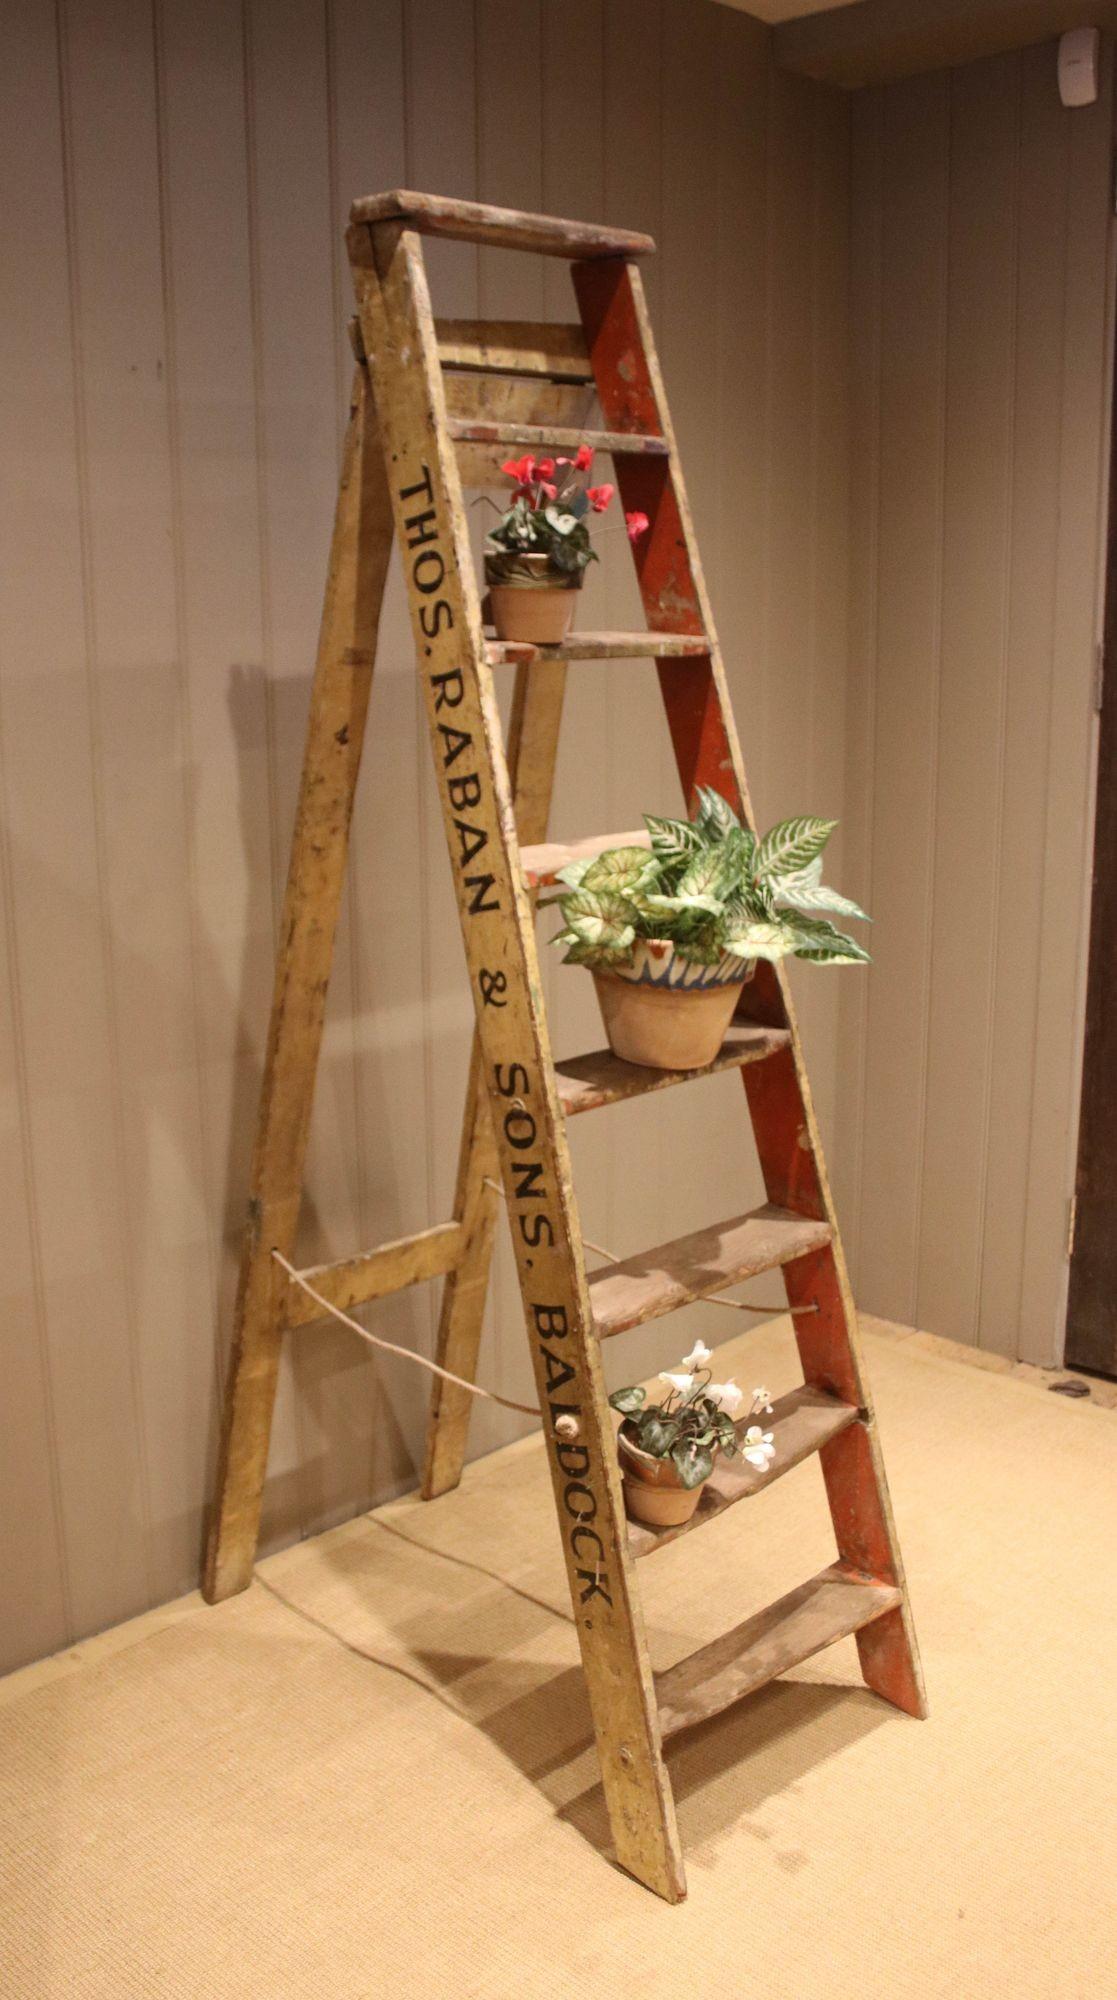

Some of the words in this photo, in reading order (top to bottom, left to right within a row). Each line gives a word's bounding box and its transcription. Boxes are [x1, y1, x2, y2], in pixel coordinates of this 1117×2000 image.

[399, 464, 454, 656] THOS.
[430, 667, 500, 916] RABAN
[478, 967, 507, 1008] &
